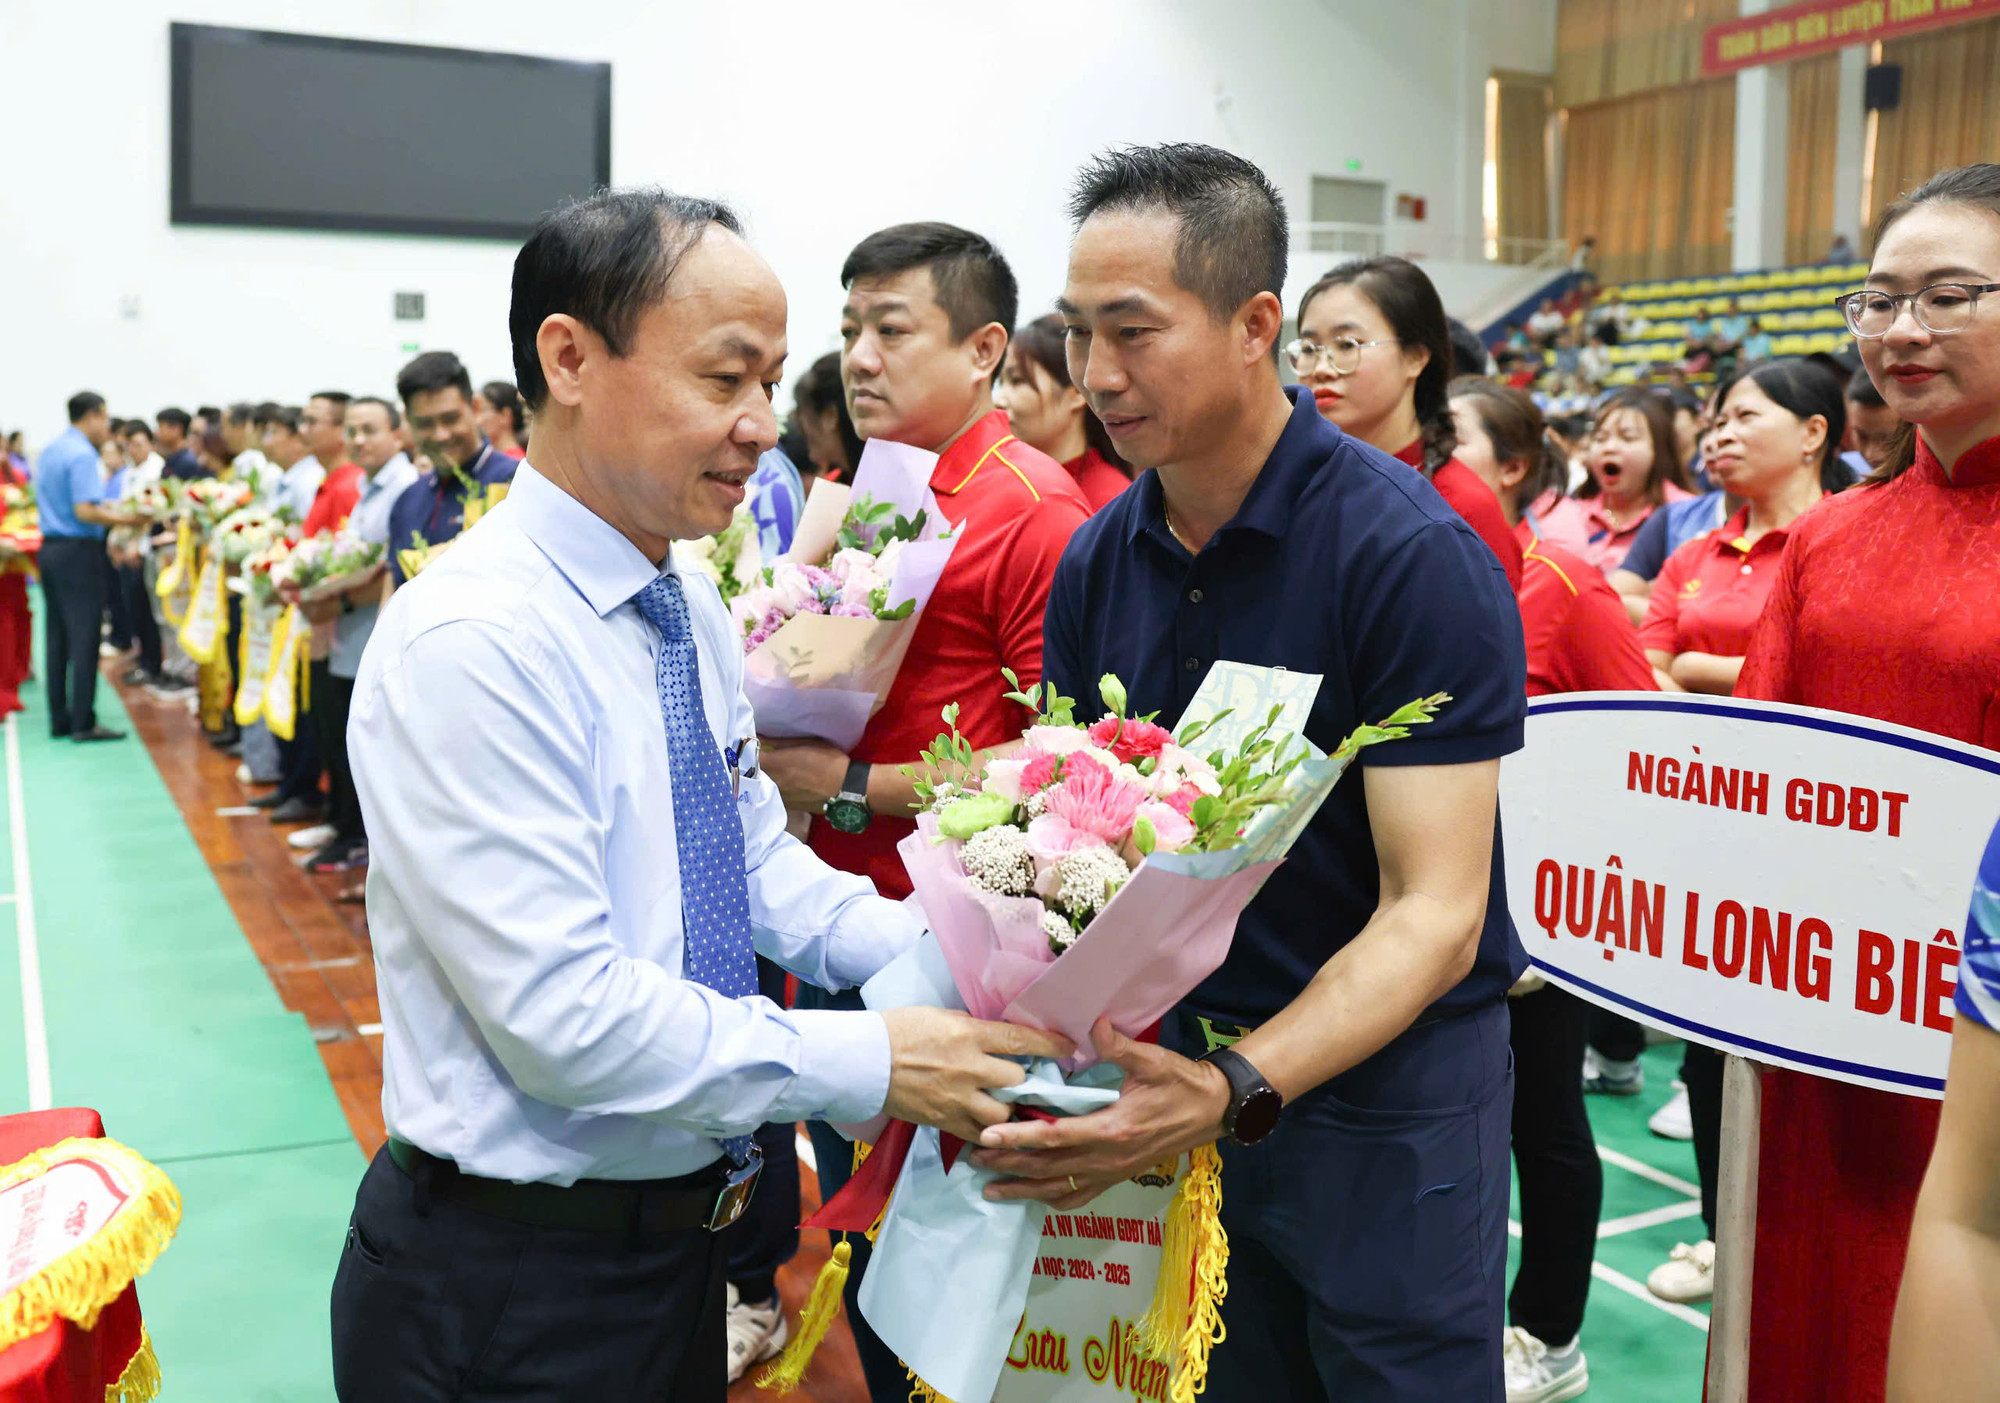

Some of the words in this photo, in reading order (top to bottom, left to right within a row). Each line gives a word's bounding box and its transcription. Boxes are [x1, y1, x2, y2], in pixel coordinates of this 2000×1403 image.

[1627, 746, 1769, 815] NGÀNH
[1785, 778, 1909, 837] GDĐT
[1534, 855, 1666, 961] QUẬN
[1682, 891, 1833, 1003] LONG
[1854, 928, 1963, 1034] BIÊ
[1056, 1215, 1074, 1237] NV
[1076, 1211, 1116, 1240] NGÀNH
[1117, 1218, 1145, 1244] GDĐT
[1147, 1216, 1162, 1247] HÀ
[1042, 1257, 1067, 1281] HỌC
[1068, 1259, 1096, 1281] 2024
[1104, 1263, 1131, 1287] 2025
[1006, 1315, 1069, 1373] Lưu
